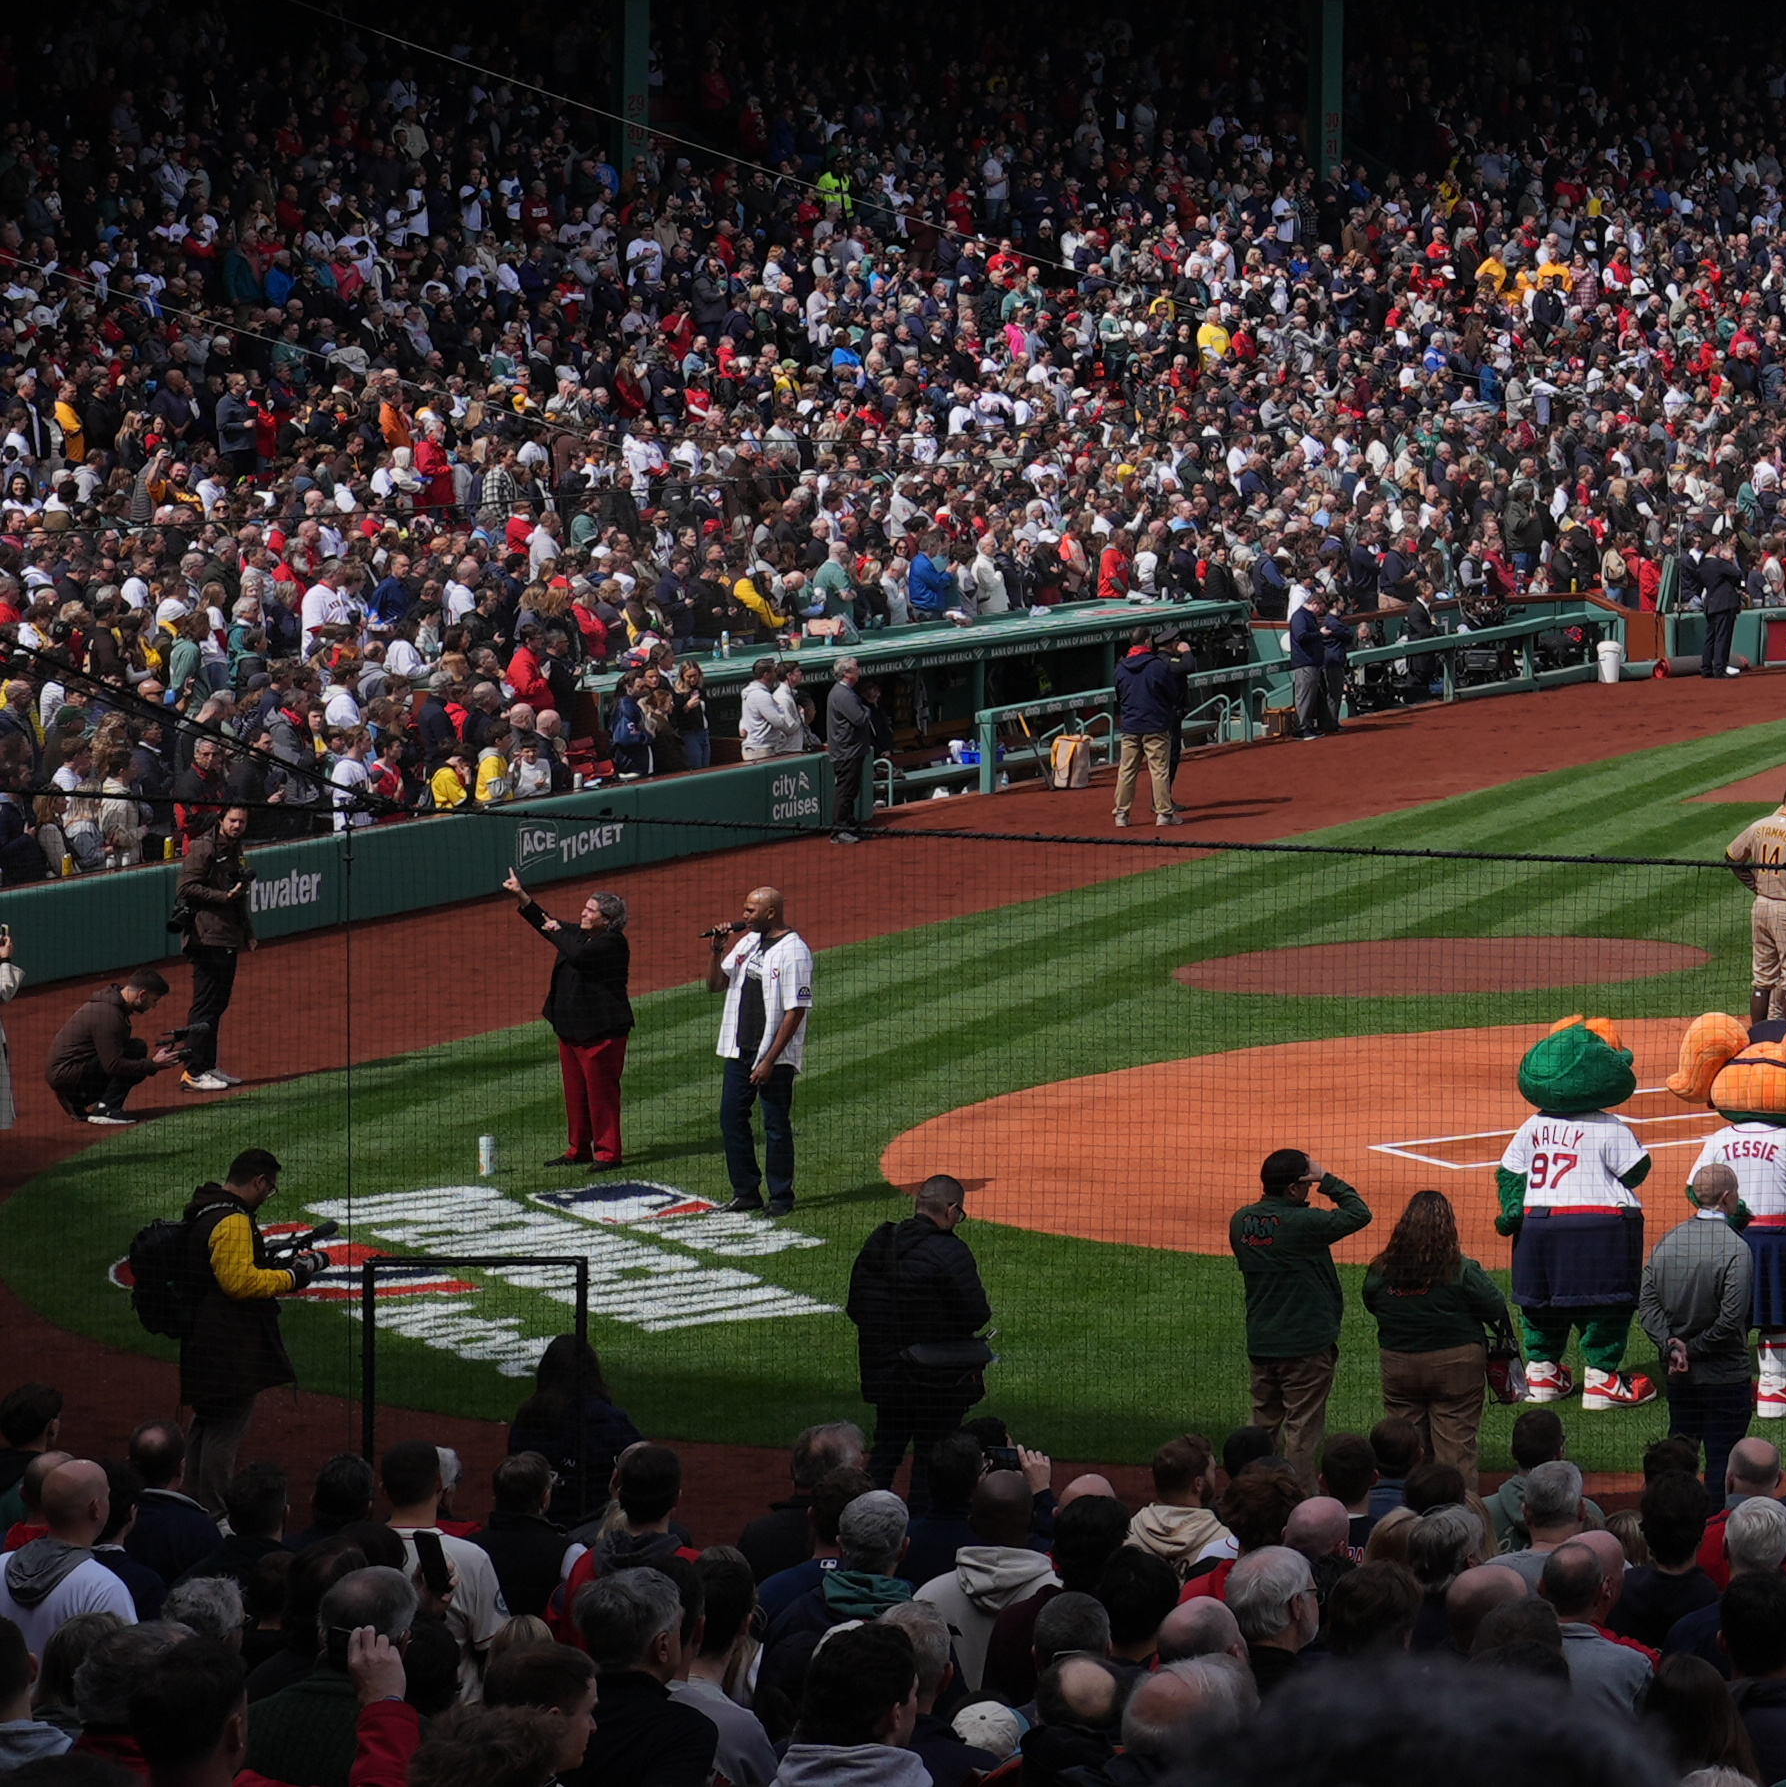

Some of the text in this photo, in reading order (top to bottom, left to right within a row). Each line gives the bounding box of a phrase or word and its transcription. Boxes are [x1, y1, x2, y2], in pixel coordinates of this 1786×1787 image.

[772, 774, 797, 799] city
[772, 796, 820, 821] cruises
[521, 822, 625, 864] ACE TICKET
[1760, 844, 1782, 875] 14
[1531, 1125, 1585, 1149] WALLY
[1722, 1140, 1779, 1162] TESSIE
[1530, 1152, 1578, 1189] 97
